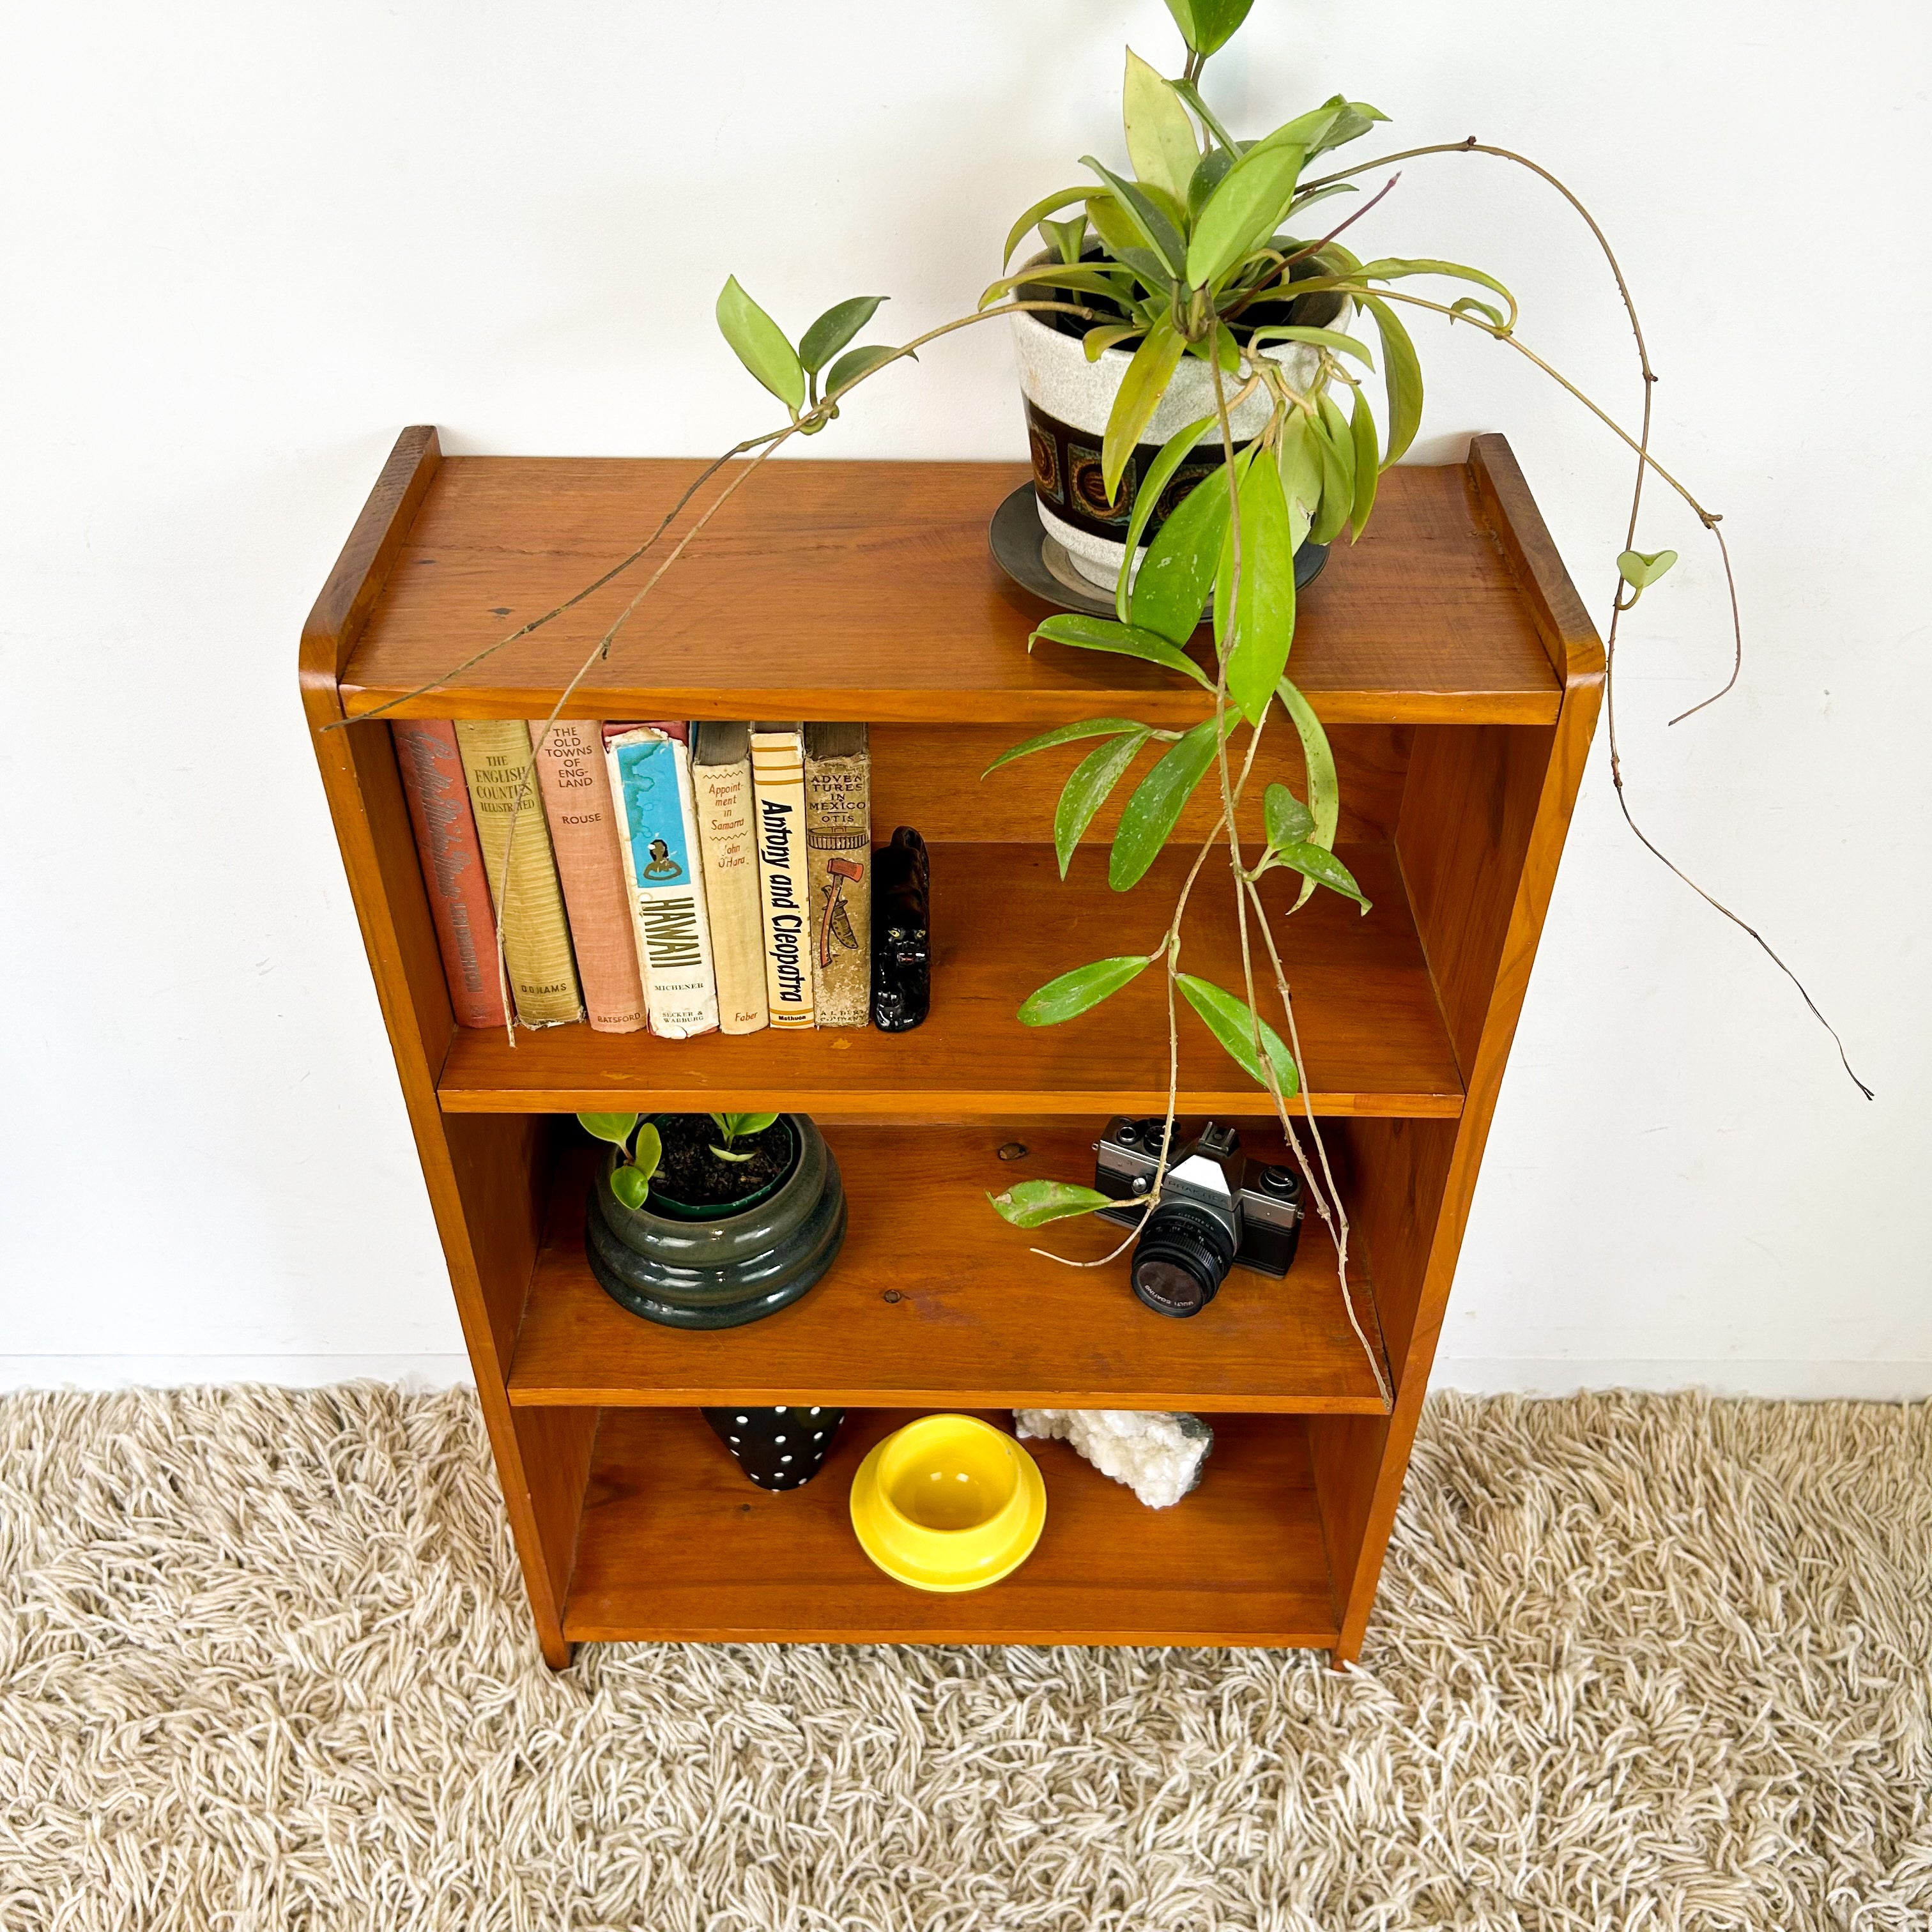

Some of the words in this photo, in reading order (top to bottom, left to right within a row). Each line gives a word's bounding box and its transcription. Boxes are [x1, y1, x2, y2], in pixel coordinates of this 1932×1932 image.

[553, 727, 578, 736] THE
[554, 737, 581, 747] OLD
[545, 746, 593, 757] TOWNS
[486, 756, 508, 766] THE
[564, 758, 581, 767] OF
[473, 767, 526, 783] ENGLISH
[558, 769, 589, 778] ENG-
[559, 778, 593, 788] LAND
[477, 782, 532, 799] COUNTIS
[709, 783, 744, 796] Appoint-
[480, 799, 534, 812] ILLUSTRTED
[715, 796, 737, 806] ment
[562, 813, 601, 824] ROUSE
[724, 809, 732, 817] in
[711, 818, 744, 831] Samarra
[760, 799, 793, 870] Antony
[769, 874, 800, 909] and
[640, 897, 702, 968] HAWAII
[769, 914, 806, 1002] Cleopatra
[521, 983, 567, 993] ODHAMS
[654, 983, 704, 991] MICHENER
[597, 1012, 641, 1023] BATSFORD
[735, 1011, 758, 1022] Faber
[1168, 1181, 1227, 1204] PRAKTICA
[1145, 1284, 1171, 1305] COATING
